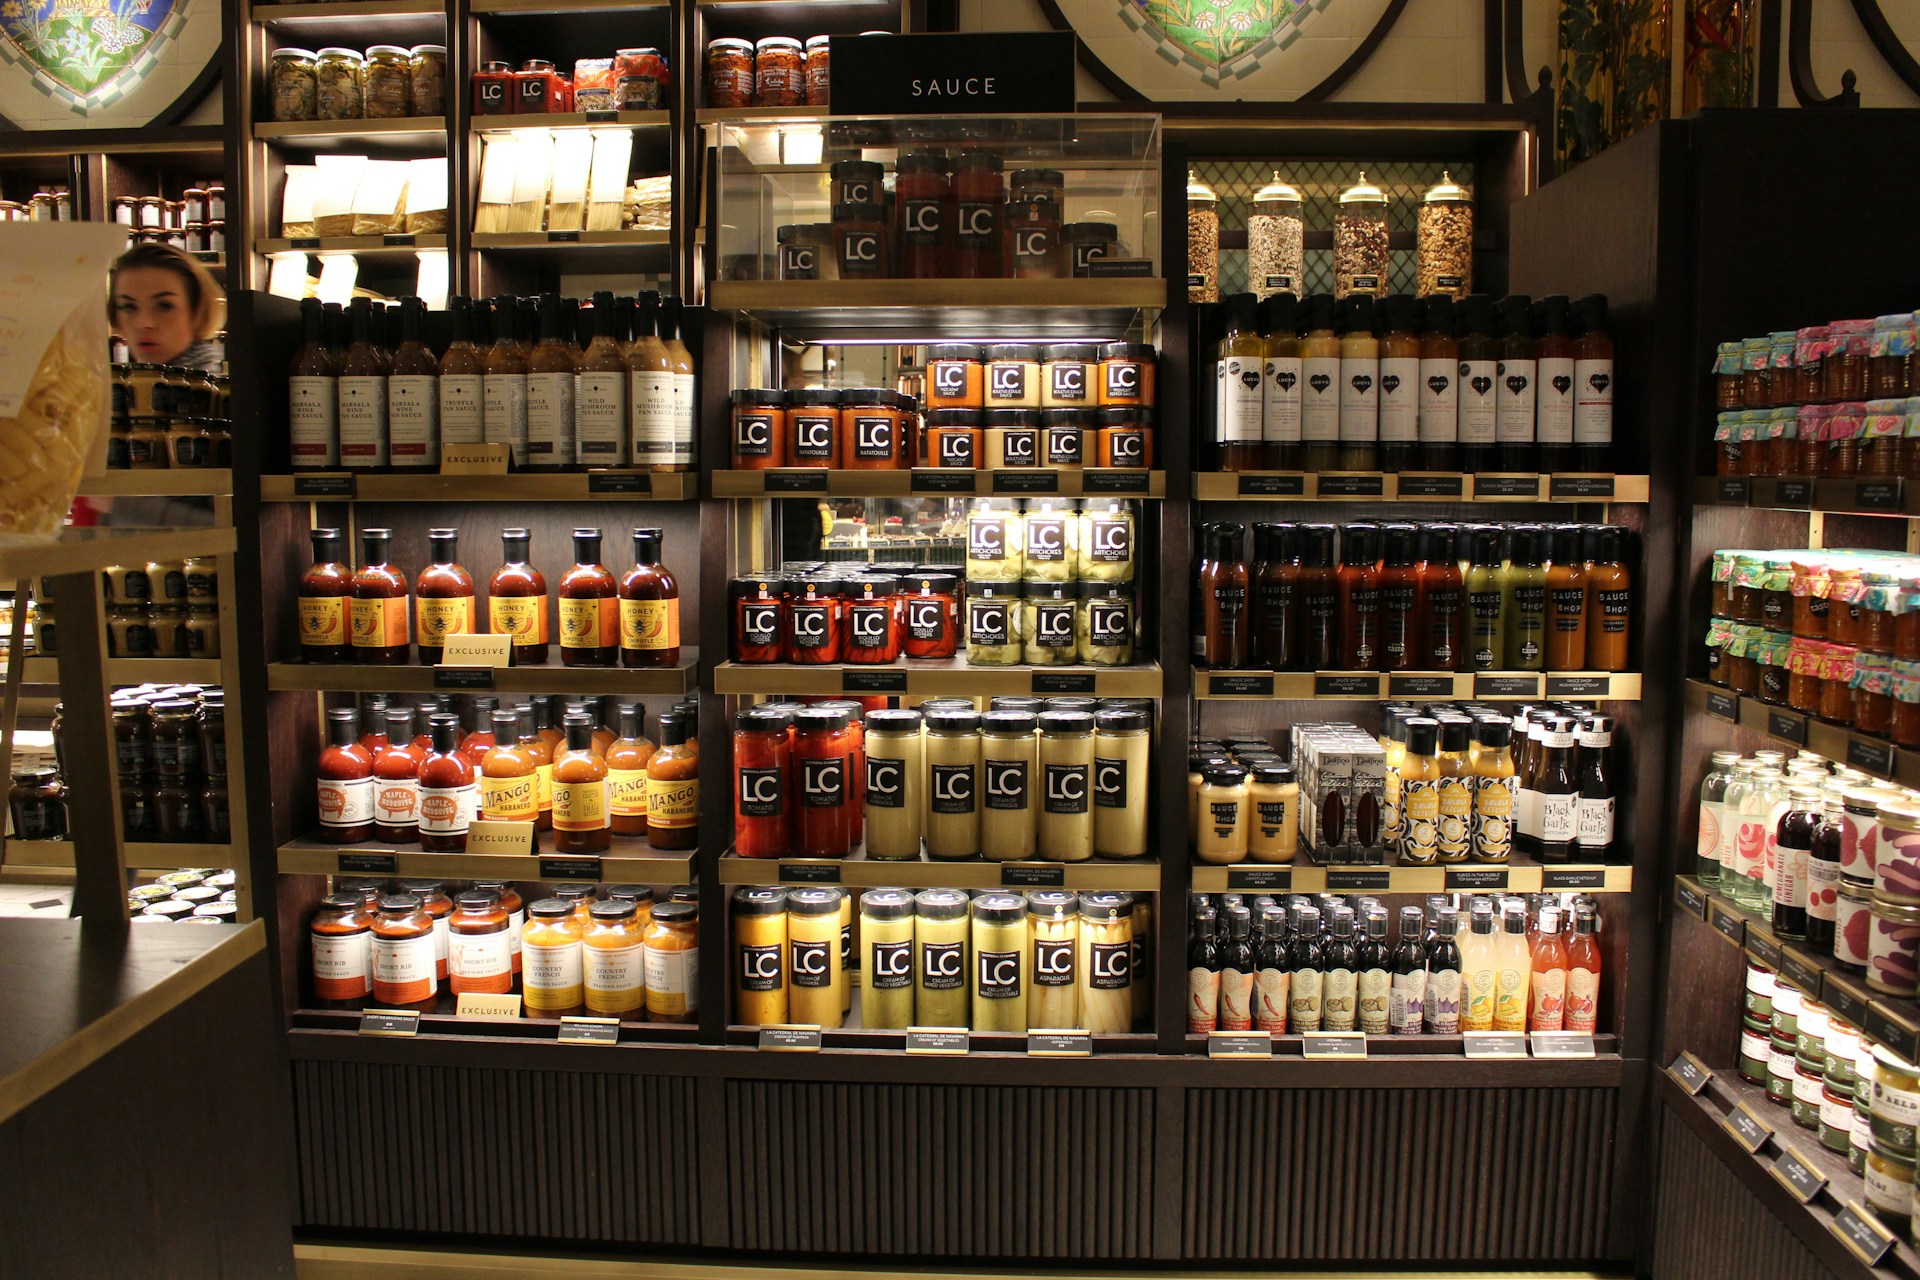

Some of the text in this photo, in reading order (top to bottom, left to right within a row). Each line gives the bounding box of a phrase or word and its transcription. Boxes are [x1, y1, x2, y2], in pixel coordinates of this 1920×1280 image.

[482, 84, 501, 100] LC
[522, 82, 541, 97] LC
[911, 77, 996, 96] SAUCE
[843, 184, 868, 202] LC
[905, 205, 939, 232] LC
[958, 208, 992, 235] LC
[846, 237, 877, 260] LC
[1016, 232, 1047, 256] LC
[788, 251, 813, 270] LC
[936, 366, 963, 387] LC
[993, 369, 1020, 389] LC
[1055, 369, 1081, 389] LC
[1109, 367, 1136, 388] LC
[738, 421, 768, 445] LC
[798, 423, 829, 447] LC
[859, 423, 890, 447] LC
[943, 437, 970, 457] LC
[1007, 436, 1032, 456] LC
[1051, 434, 1077, 454] LC
[1113, 436, 1141, 456] LC
[1724, 444, 1741, 456] taste
[970, 524, 1000, 549] LC
[1029, 524, 1060, 549] LC
[1095, 526, 1126, 550] LC
[1215, 589, 1245, 597] SAUCE
[1261, 585, 1292, 594] SAUCE
[1352, 590, 1379, 600] SAUCE
[1383, 587, 1414, 598] SAUCE
[1428, 591, 1458, 600] SAUCE
[1515, 588, 1545, 598] SAUCE
[1552, 591, 1583, 600] SAUCE
[1599, 591, 1629, 600] SAUCE
[1220, 601, 1244, 610] SHOP
[1267, 598, 1290, 607] SHOP
[1306, 596, 1336, 604] SAUCE
[1389, 600, 1412, 610] SHOP
[1470, 594, 1500, 603] SAUCE
[303, 604, 328, 612] HONEY
[426, 605, 454, 613] HONEY
[498, 604, 525, 612] HONEY
[627, 607, 654, 615] HONEY
[1312, 609, 1334, 617] SHOP
[1357, 604, 1378, 613] SHOP
[1434, 604, 1457, 613] SHOP
[1475, 607, 1499, 616] SHOP
[1521, 602, 1543, 611] SHOP
[1557, 604, 1581, 612] SHOP
[1605, 605, 1628, 613] SHOP
[1764, 604, 1782, 613] taste
[745, 610, 776, 633] LC
[909, 605, 939, 628] LC
[972, 609, 1002, 633] LC
[1040, 611, 1071, 635] LC
[1095, 610, 1125, 634] LC
[794, 612, 825, 636] LC
[853, 612, 885, 636] LC
[448, 647, 505, 655] EXCLUSIVE
[1357, 649, 1373, 657] taste
[1387, 644, 1405, 653] taste
[1434, 648, 1452, 657] taste
[1521, 647, 1539, 655] taste
[1475, 652, 1494, 661] taste
[1764, 675, 1781, 691] taste
[805, 766, 840, 793] LC
[867, 763, 899, 793] LC
[987, 767, 1022, 796] LC
[742, 775, 778, 802] LC
[935, 772, 971, 800] LC
[1048, 771, 1084, 800] LC
[386, 790, 408, 799] MAPLE
[484, 782, 531, 809] MANGO
[649, 786, 694, 811] MANGO
[426, 799, 448, 807] MAPLE
[499, 802, 531, 811] HABANERO
[747, 804, 773, 812] TOMATO
[1210, 804, 1237, 812] SAUCE
[1258, 804, 1284, 812] SAUCE
[1440, 805, 1467, 813] KETCHUP
[1442, 799, 1467, 807] BANANA
[1484, 799, 1509, 807] BANANA
[1544, 803, 1570, 817] Black
[662, 806, 695, 815] HABANERO
[1581, 806, 1608, 820] Black
[1216, 815, 1236, 823] SHOP
[1263, 814, 1282, 823] SHOP
[1543, 816, 1571, 830] Garlic
[1580, 820, 1608, 834] Garlic
[472, 834, 527, 843] EXCLUSIVE
[1723, 845, 1731, 866] WATER
[1775, 853, 1785, 901] POMEGRANATE
[1784, 874, 1794, 903] VINEGAR
[464, 957, 485, 965] SHORT
[744, 951, 779, 978] LC
[793, 947, 826, 974] LC
[876, 949, 910, 976] LC
[926, 950, 960, 976] LC
[1038, 947, 1072, 973] LC
[1094, 951, 1128, 977] LC
[981, 958, 1016, 985] LC
[1039, 974, 1070, 982] ASPARAGUS
[462, 1007, 515, 1016] EXCLUSIVE
[1886, 1094, 1917, 1110] BELD
